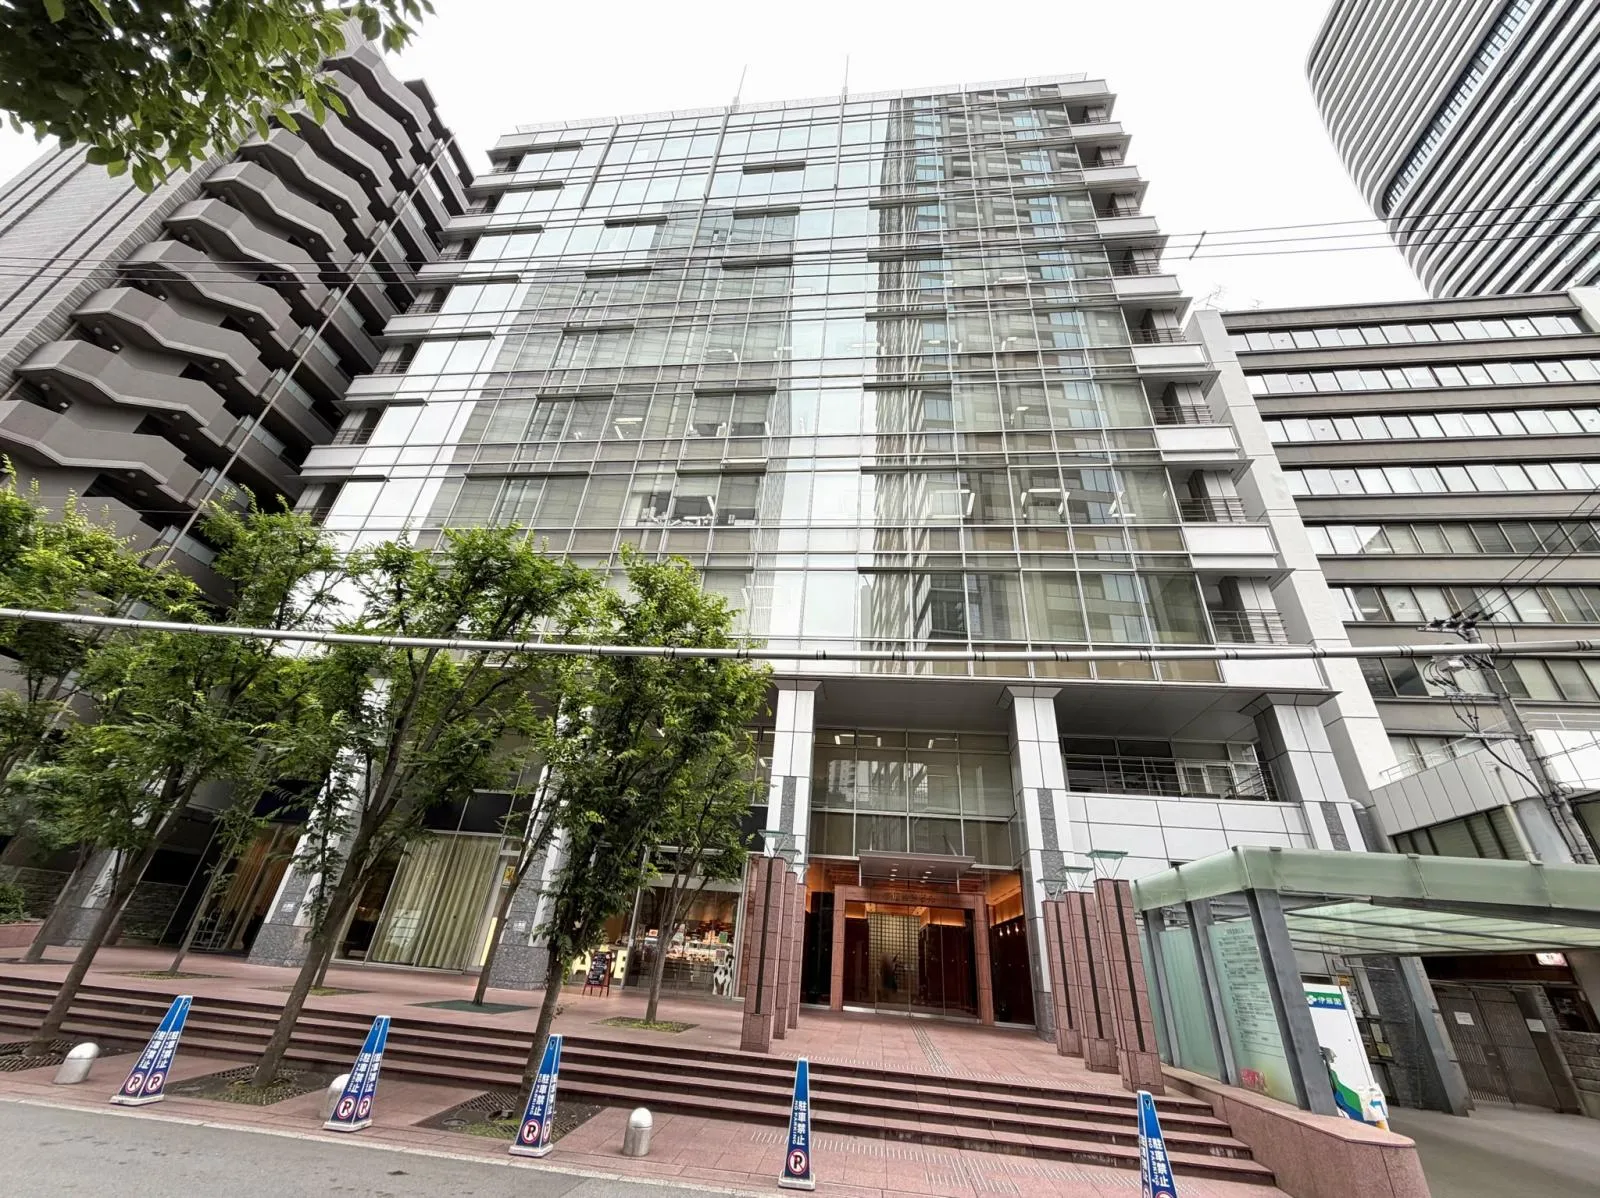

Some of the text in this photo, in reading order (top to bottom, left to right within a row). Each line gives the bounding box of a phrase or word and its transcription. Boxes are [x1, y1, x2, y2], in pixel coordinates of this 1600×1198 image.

[534, 1074, 550, 1116] 駐車禁止
[797, 1101, 807, 1146] 駐車禁止
[1152, 1137, 1170, 1187] 駐車禁止
